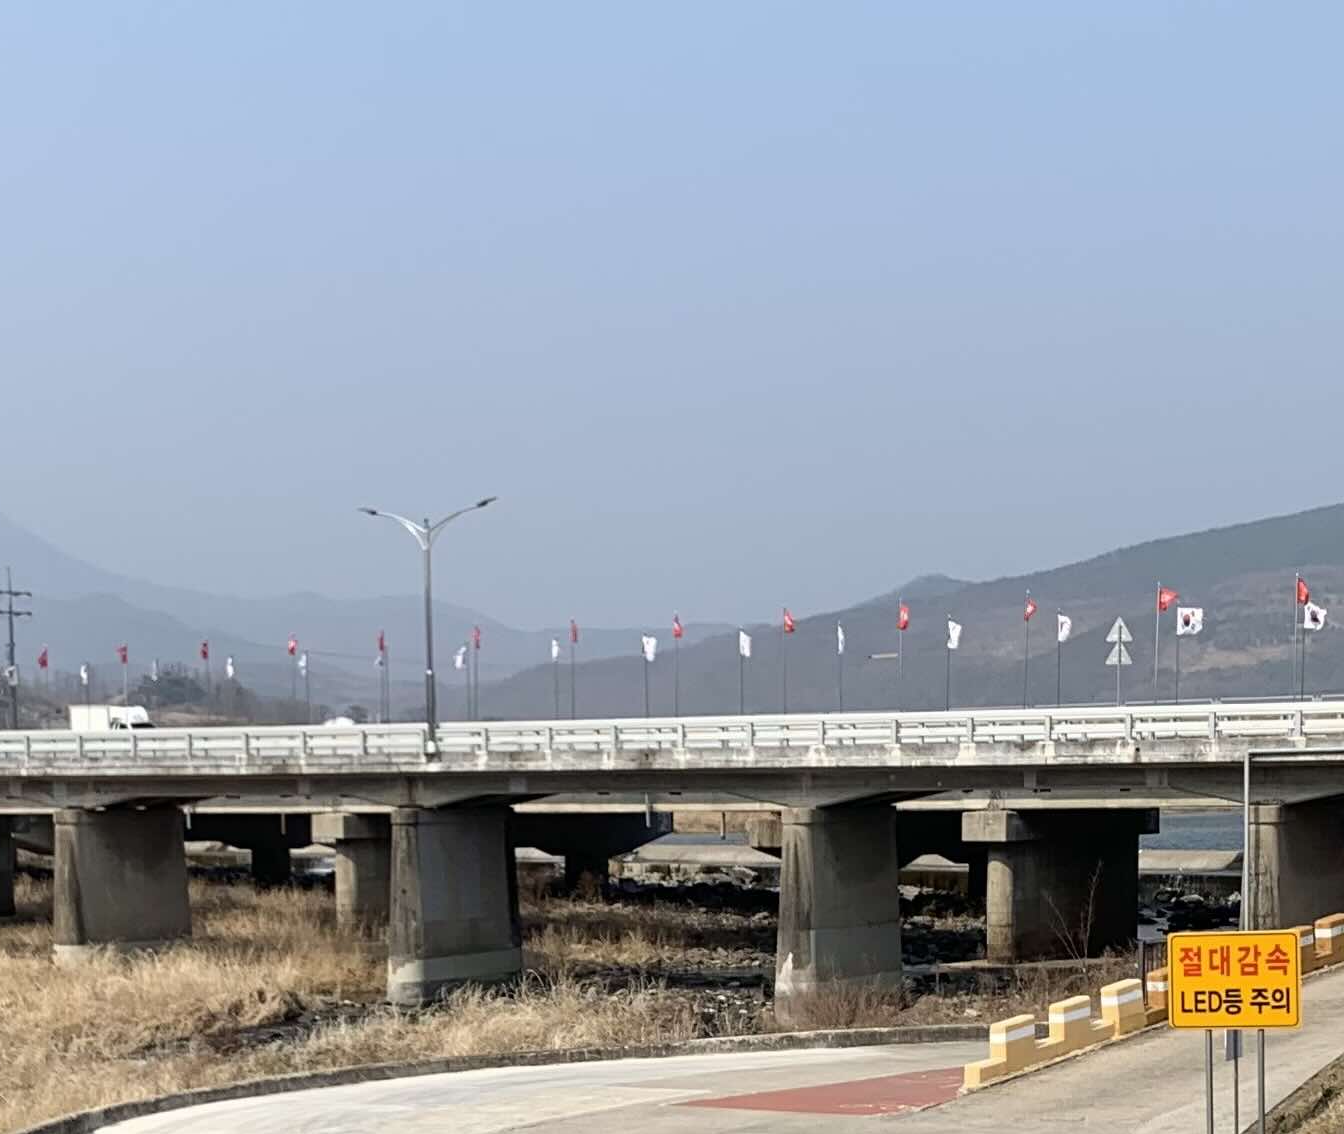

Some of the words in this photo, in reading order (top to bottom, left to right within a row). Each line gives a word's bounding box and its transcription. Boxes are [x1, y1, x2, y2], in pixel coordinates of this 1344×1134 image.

[1179, 944, 1291, 977] 절대감속
[1181, 988, 1244, 1016] LED등
[1249, 987, 1292, 1014] 주의
